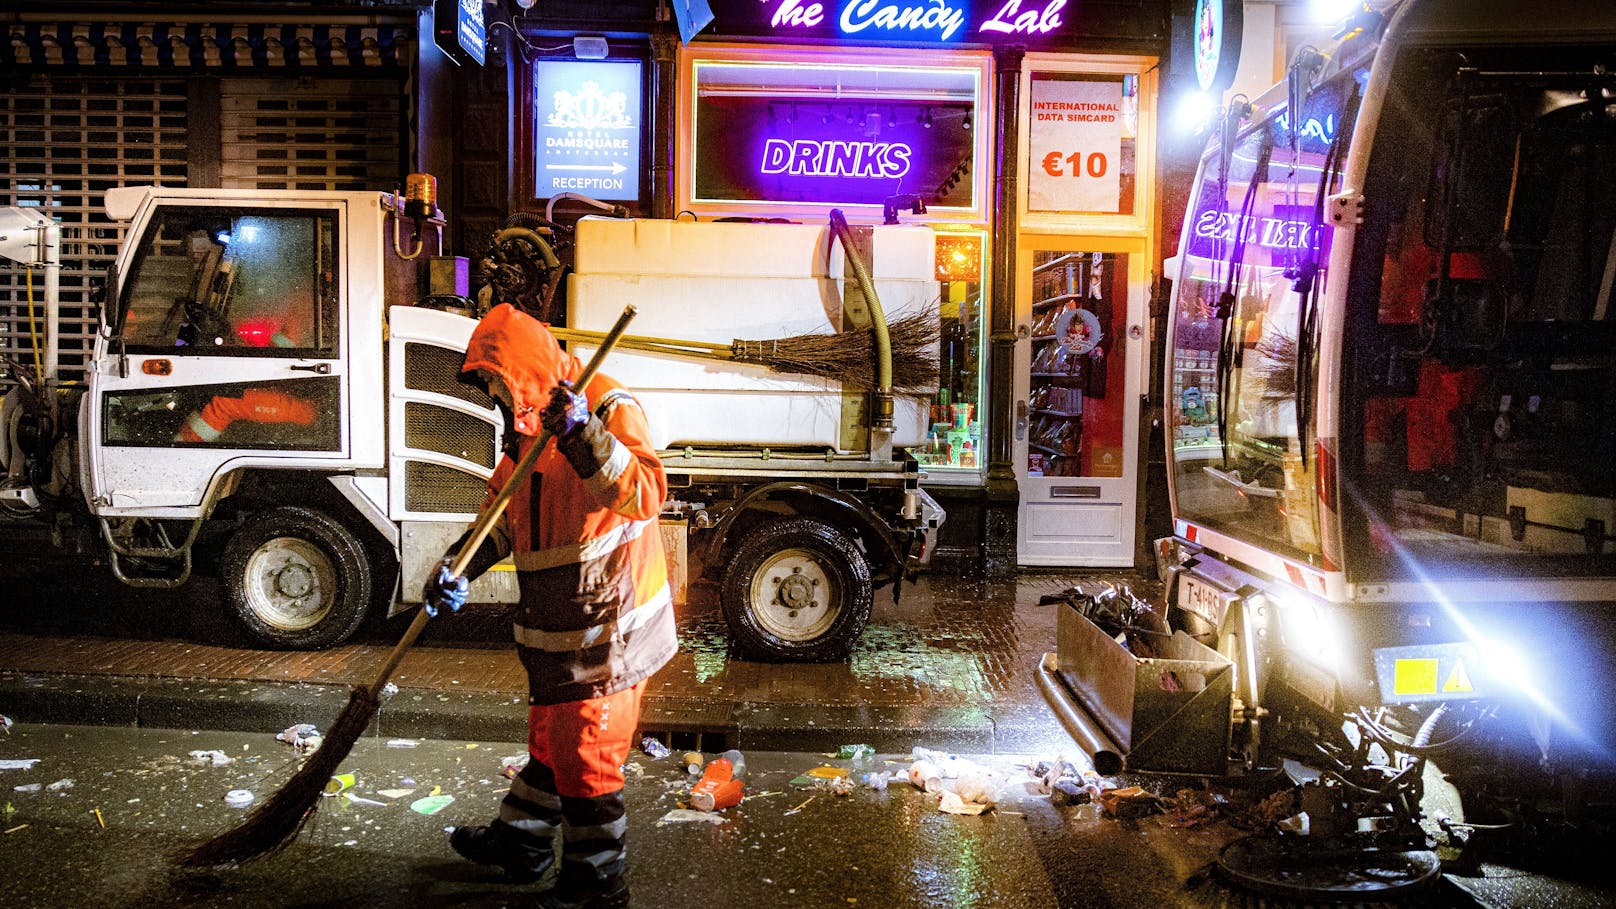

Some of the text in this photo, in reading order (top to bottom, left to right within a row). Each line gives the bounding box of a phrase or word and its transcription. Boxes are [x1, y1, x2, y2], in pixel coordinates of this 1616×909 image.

[839, 0, 965, 41] Candy
[978, 0, 1068, 35] Lab
[1034, 102, 1119, 112] INTERNATIONAL
[1037, 113, 1064, 121] DATA
[545, 137, 630, 150] DAMSQUARE
[761, 139, 912, 178] DRINKS
[1041, 151, 1108, 178] €10
[552, 177, 623, 189] RECEPTION
